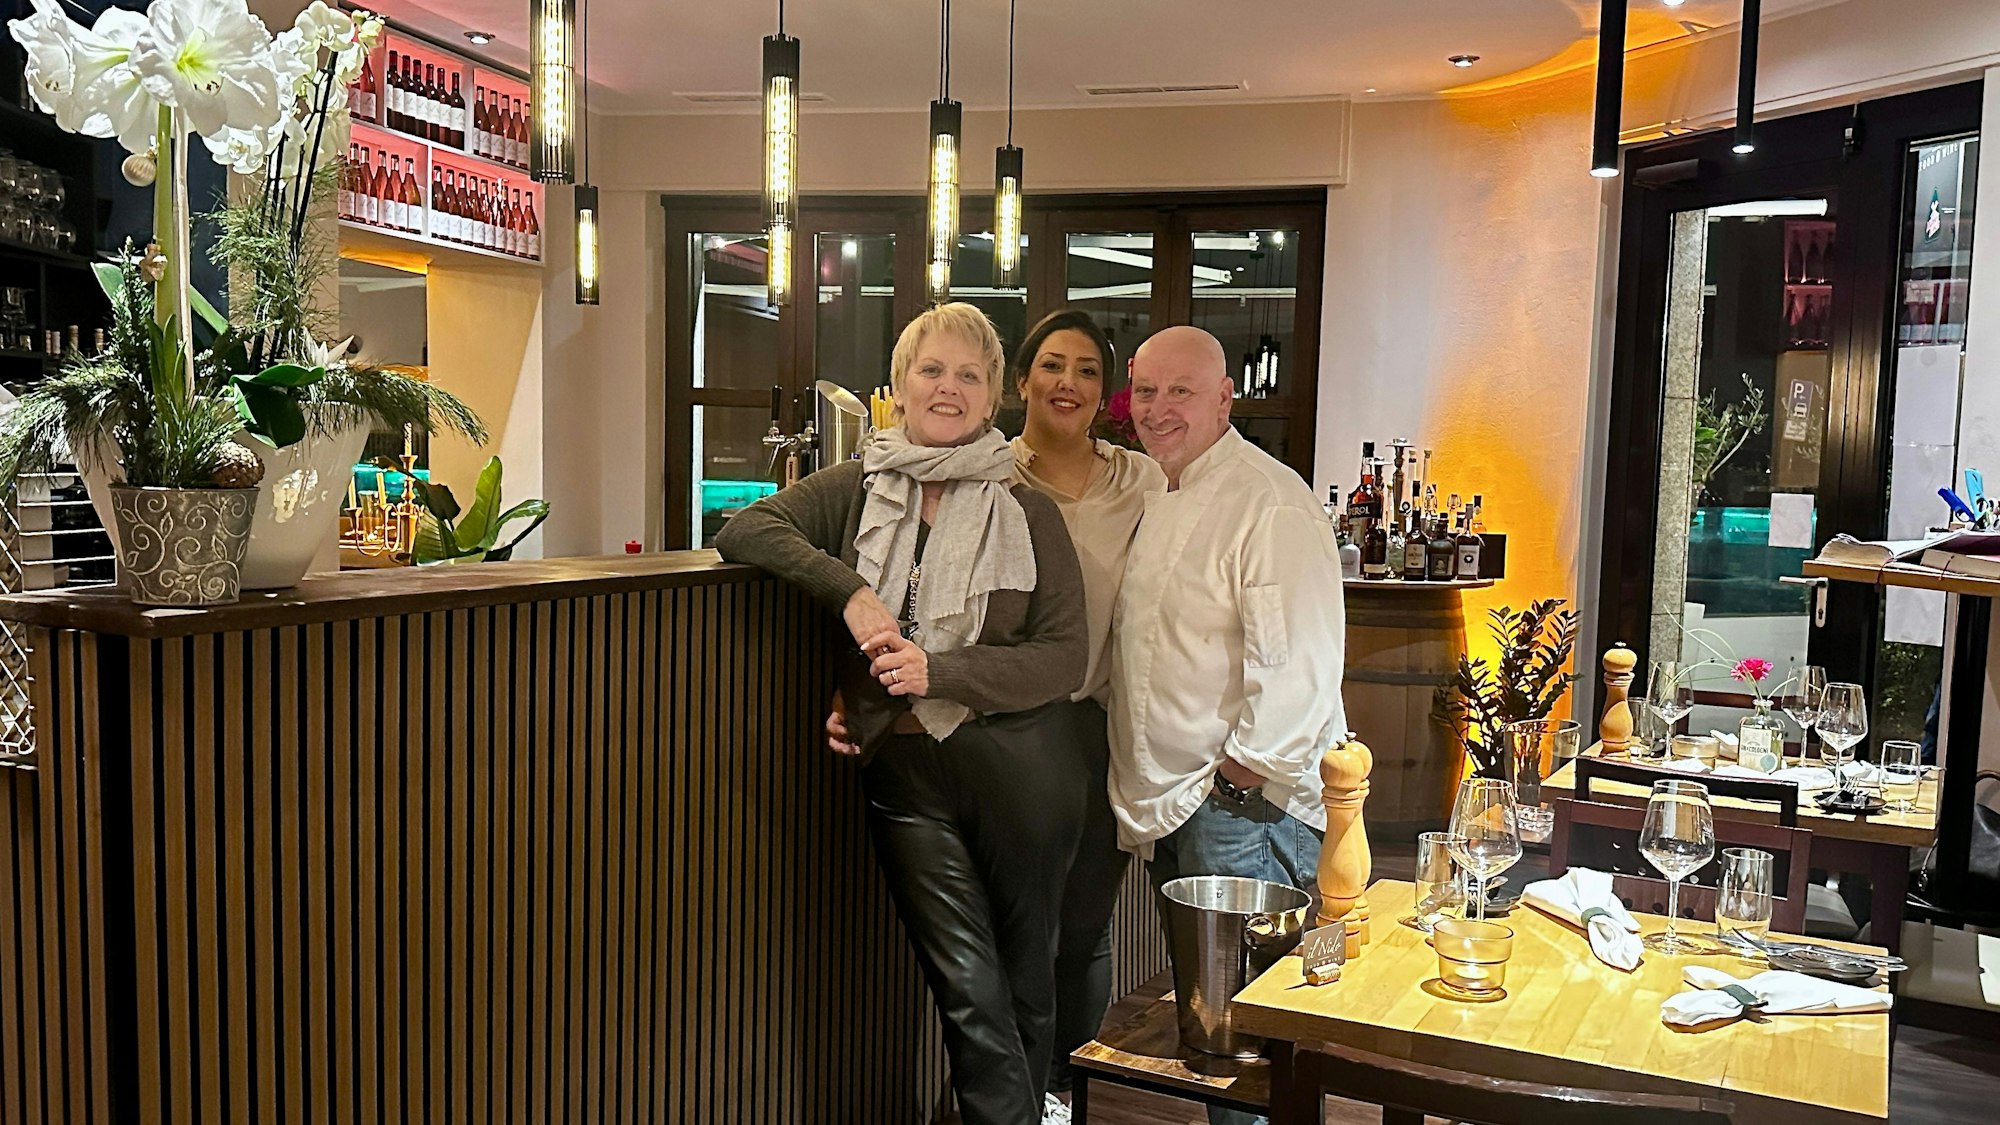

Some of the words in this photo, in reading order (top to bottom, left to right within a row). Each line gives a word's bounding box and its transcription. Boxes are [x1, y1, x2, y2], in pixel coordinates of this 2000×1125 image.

[1793, 383, 1804, 399] P
[1307, 936, 1321, 960] il
[1318, 930, 1342, 956] Nido
